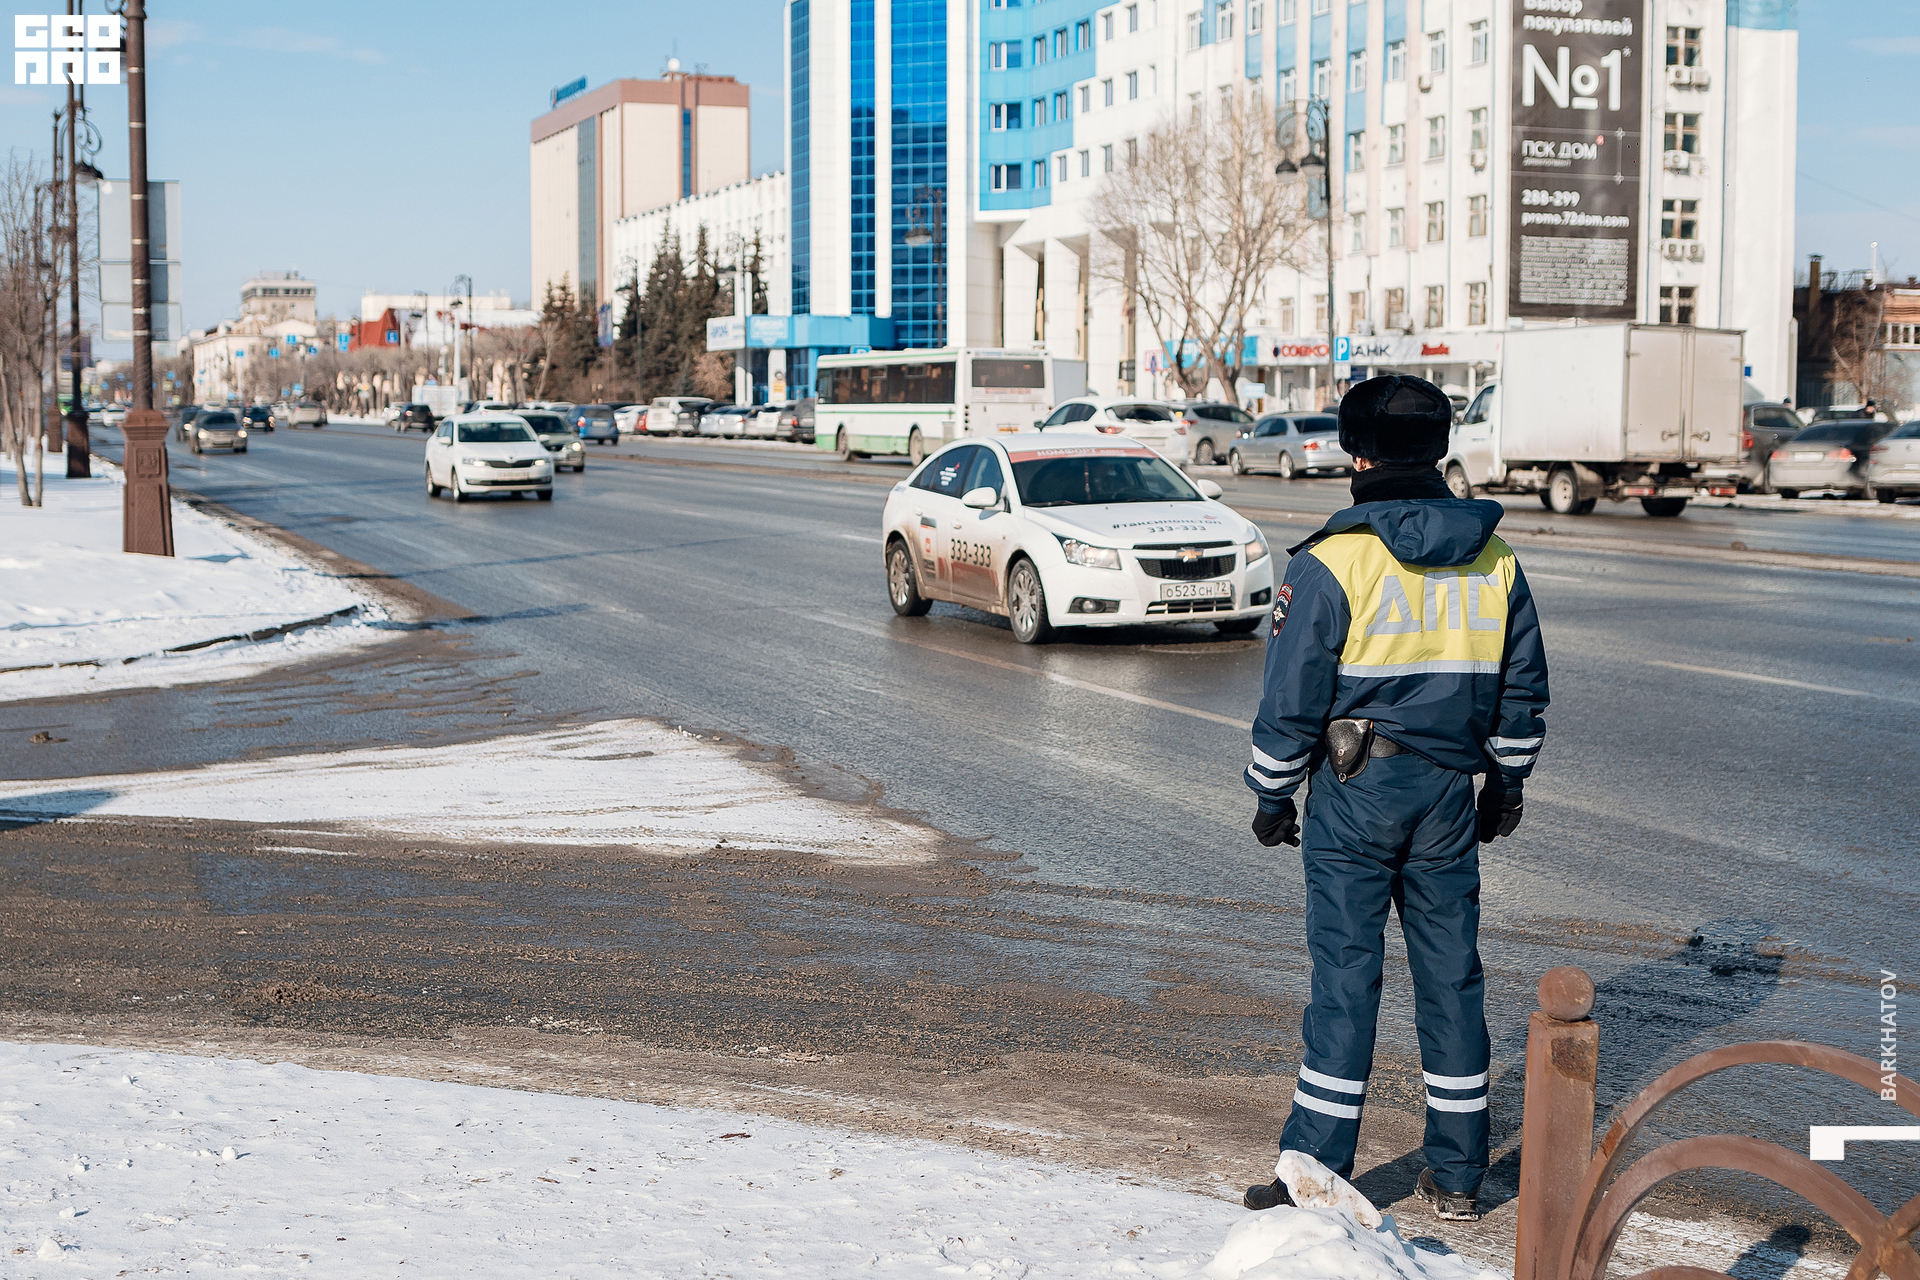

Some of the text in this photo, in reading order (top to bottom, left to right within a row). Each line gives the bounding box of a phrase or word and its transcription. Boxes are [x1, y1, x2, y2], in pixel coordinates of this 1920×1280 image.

[1523, 14, 1633, 36] покупателей
[1522, 139, 1598, 160] ПСК ДОМ
[1521, 210, 1630, 228] promo.72dom.com
[1147, 524, 1207, 533] 333-333
[951, 538, 992, 568] 333-333
[1366, 570, 1501, 637] ДПС
